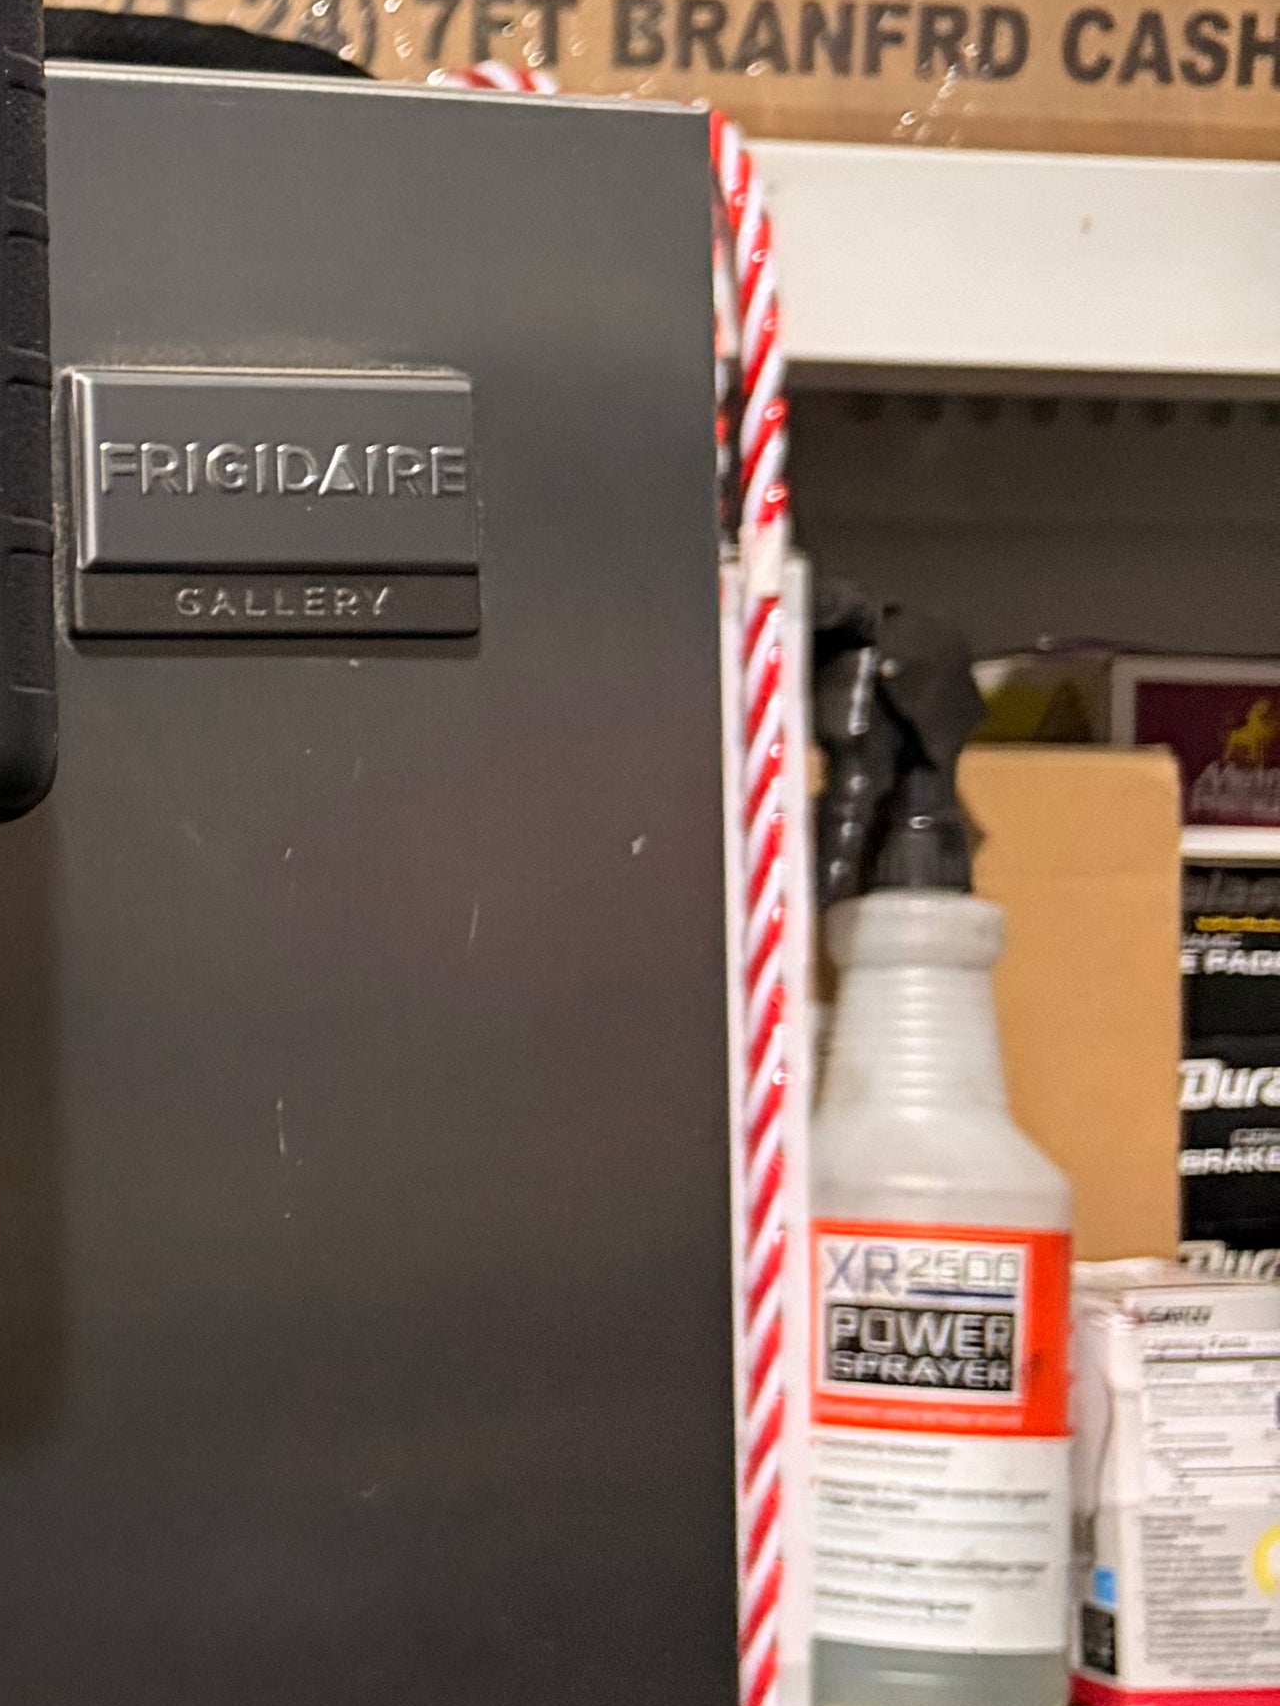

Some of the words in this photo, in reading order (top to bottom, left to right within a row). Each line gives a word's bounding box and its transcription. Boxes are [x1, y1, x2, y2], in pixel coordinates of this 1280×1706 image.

[98, 440, 468, 496] FRIGIDAIRE
[175, 586, 391, 617] GALLERY
[831, 1305, 1013, 1359] POWER
[831, 1349, 1013, 1390] SPRAYER
